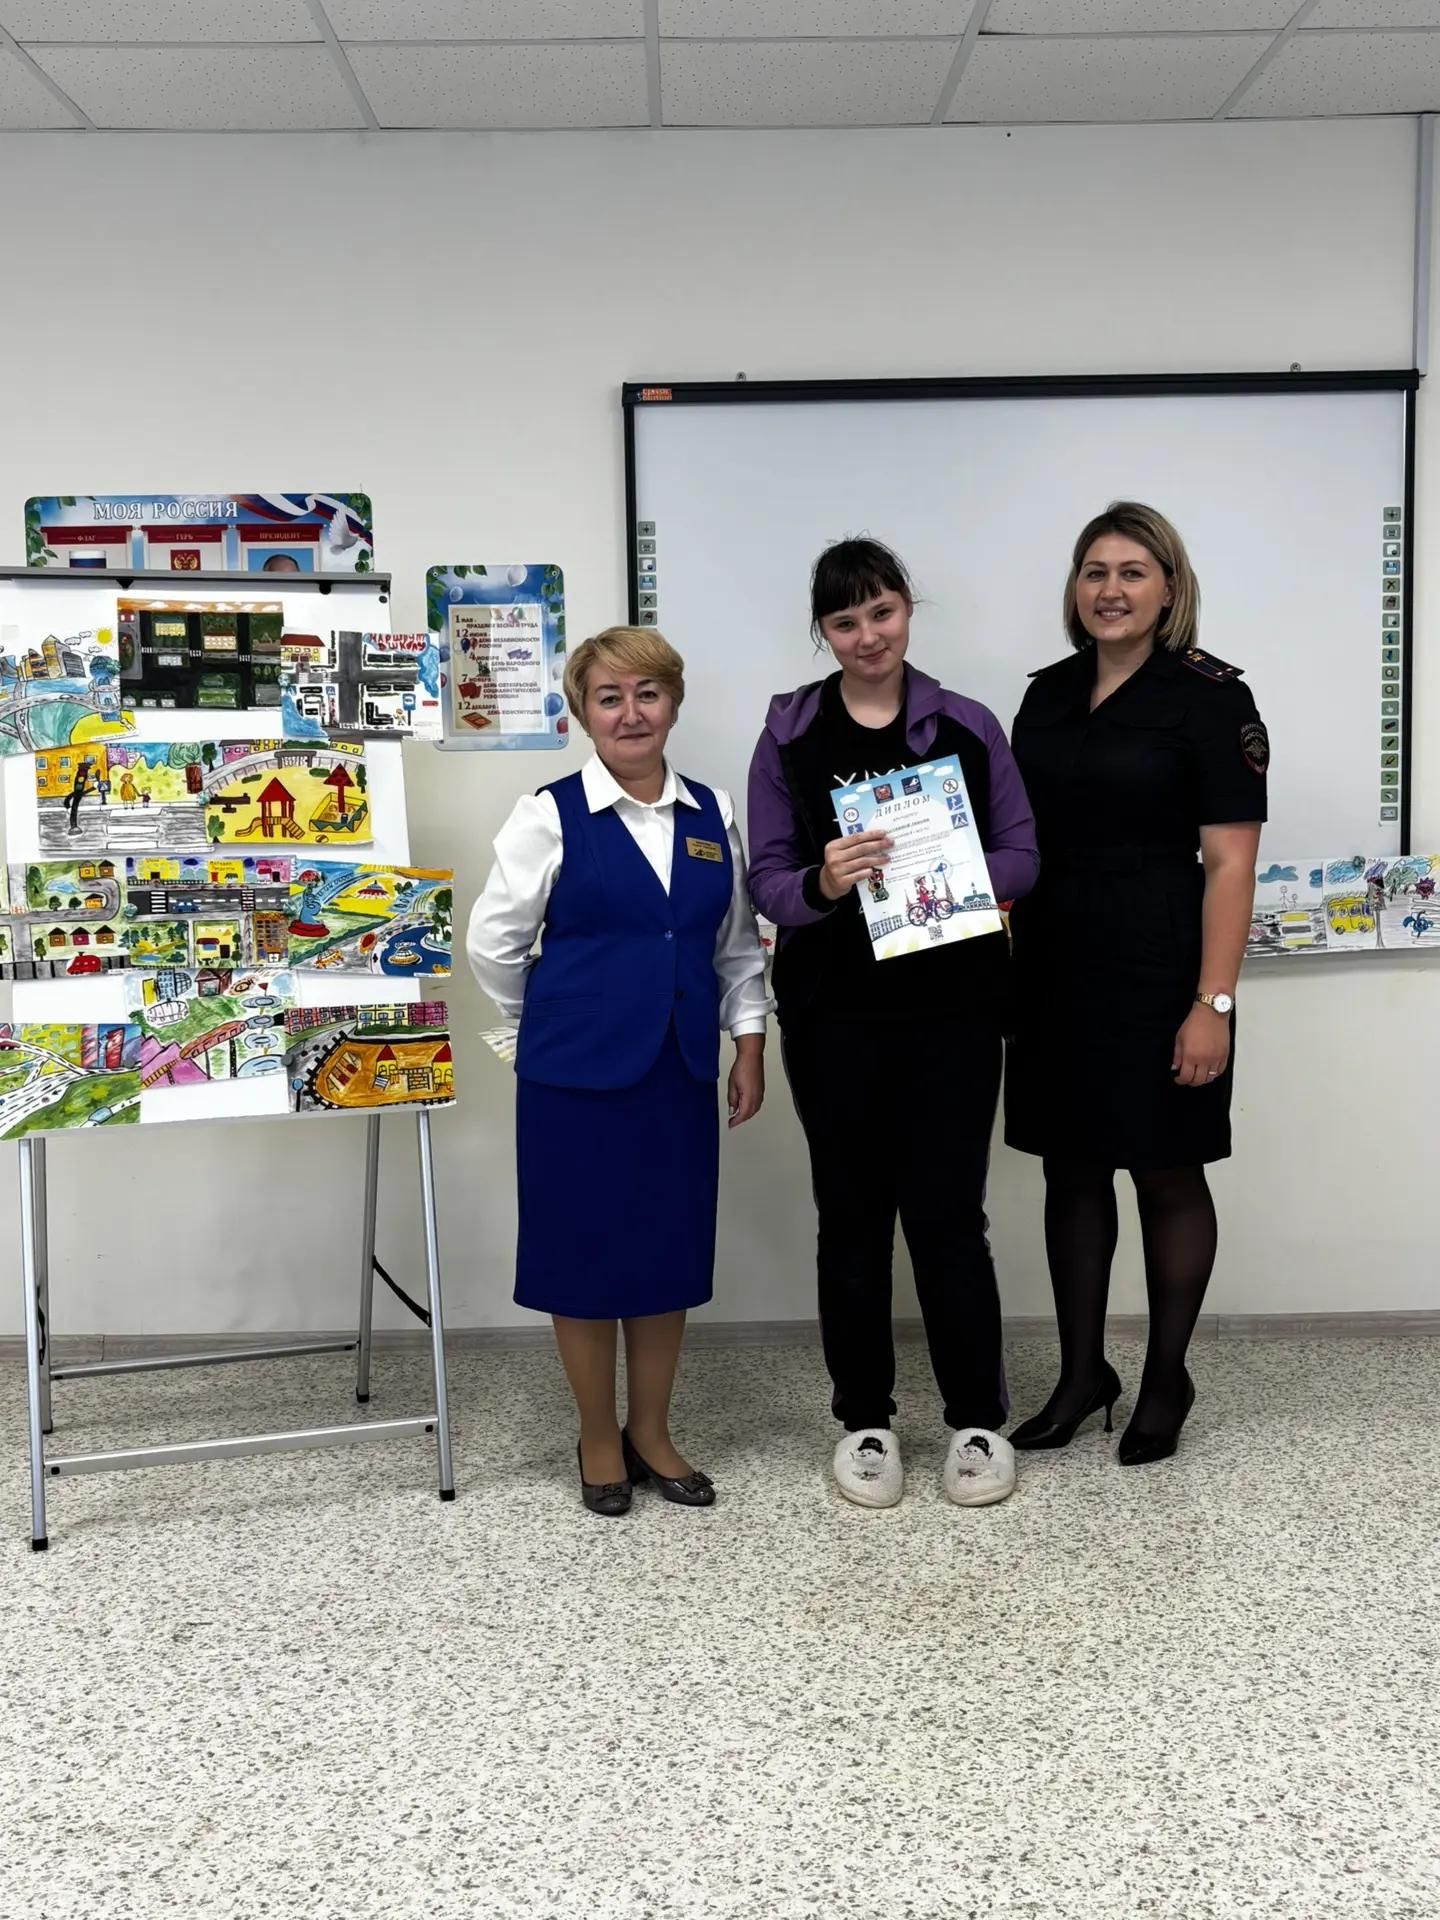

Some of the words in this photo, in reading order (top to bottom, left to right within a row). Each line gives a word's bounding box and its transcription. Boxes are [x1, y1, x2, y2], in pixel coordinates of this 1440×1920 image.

[93, 501, 142, 520] МОЯ
[152, 500, 240, 519] РОССИЯ
[456, 629, 469, 637] 12
[874, 794, 931, 819] ДИПЛОМ
